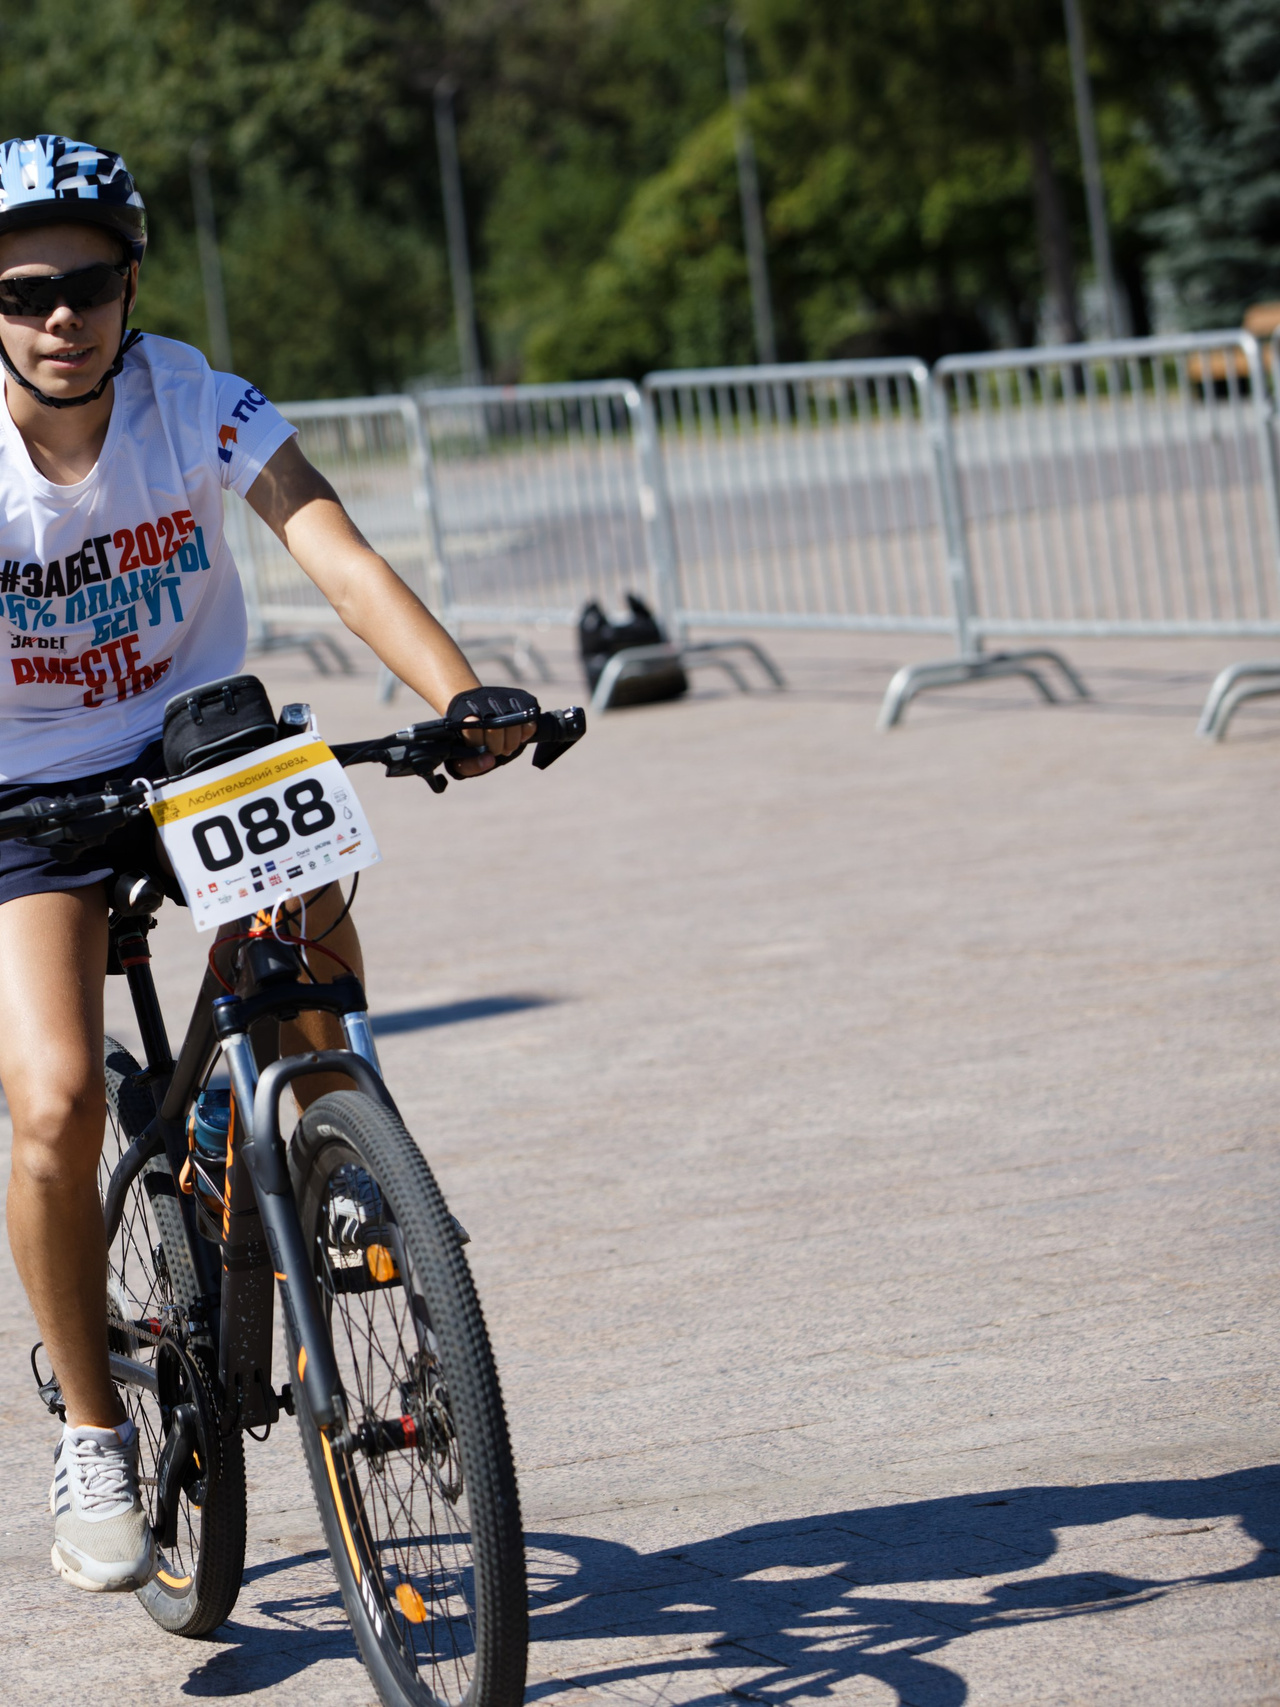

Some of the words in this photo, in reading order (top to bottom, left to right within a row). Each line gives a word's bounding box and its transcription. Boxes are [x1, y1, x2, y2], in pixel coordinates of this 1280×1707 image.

[188, 767, 273, 808] Любительский
[275, 755, 309, 773] заезд
[192, 778, 336, 872] 088
